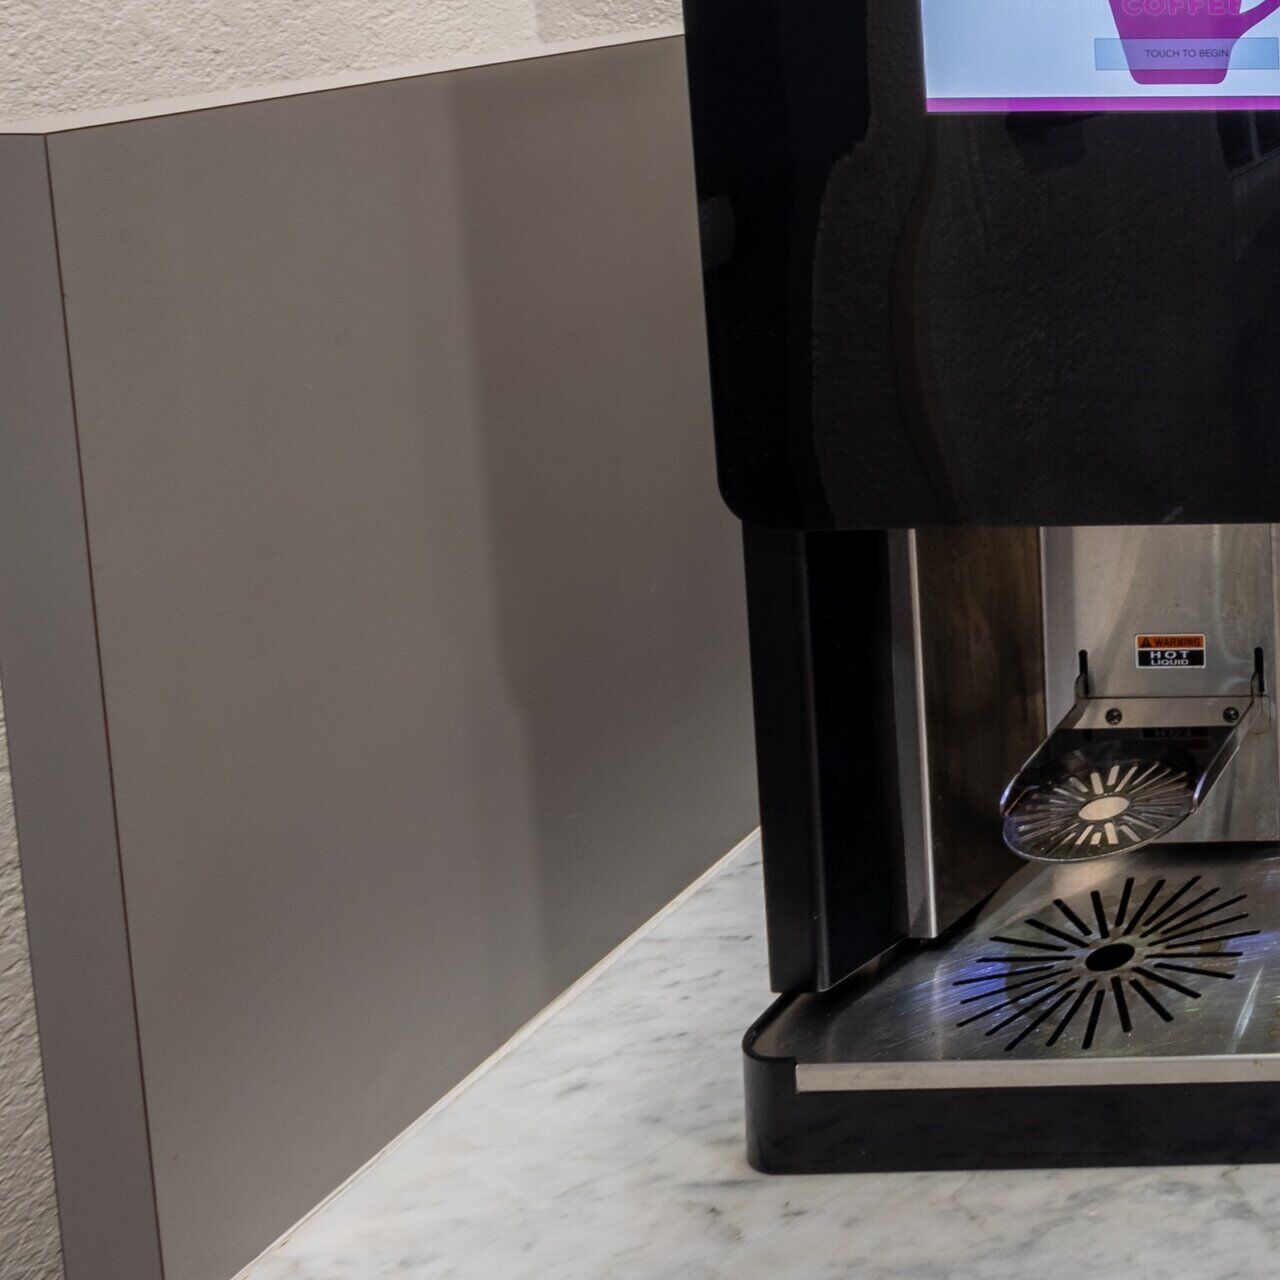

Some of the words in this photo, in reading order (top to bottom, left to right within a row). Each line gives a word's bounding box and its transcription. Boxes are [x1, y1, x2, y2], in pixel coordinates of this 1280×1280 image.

[1145, 49, 1180, 58] TOUCH
[1182, 49, 1196, 58] TO
[1199, 49, 1229, 58] BEGIN
[1154, 636, 1201, 648] WARNING
[1150, 651, 1190, 659] HOT
